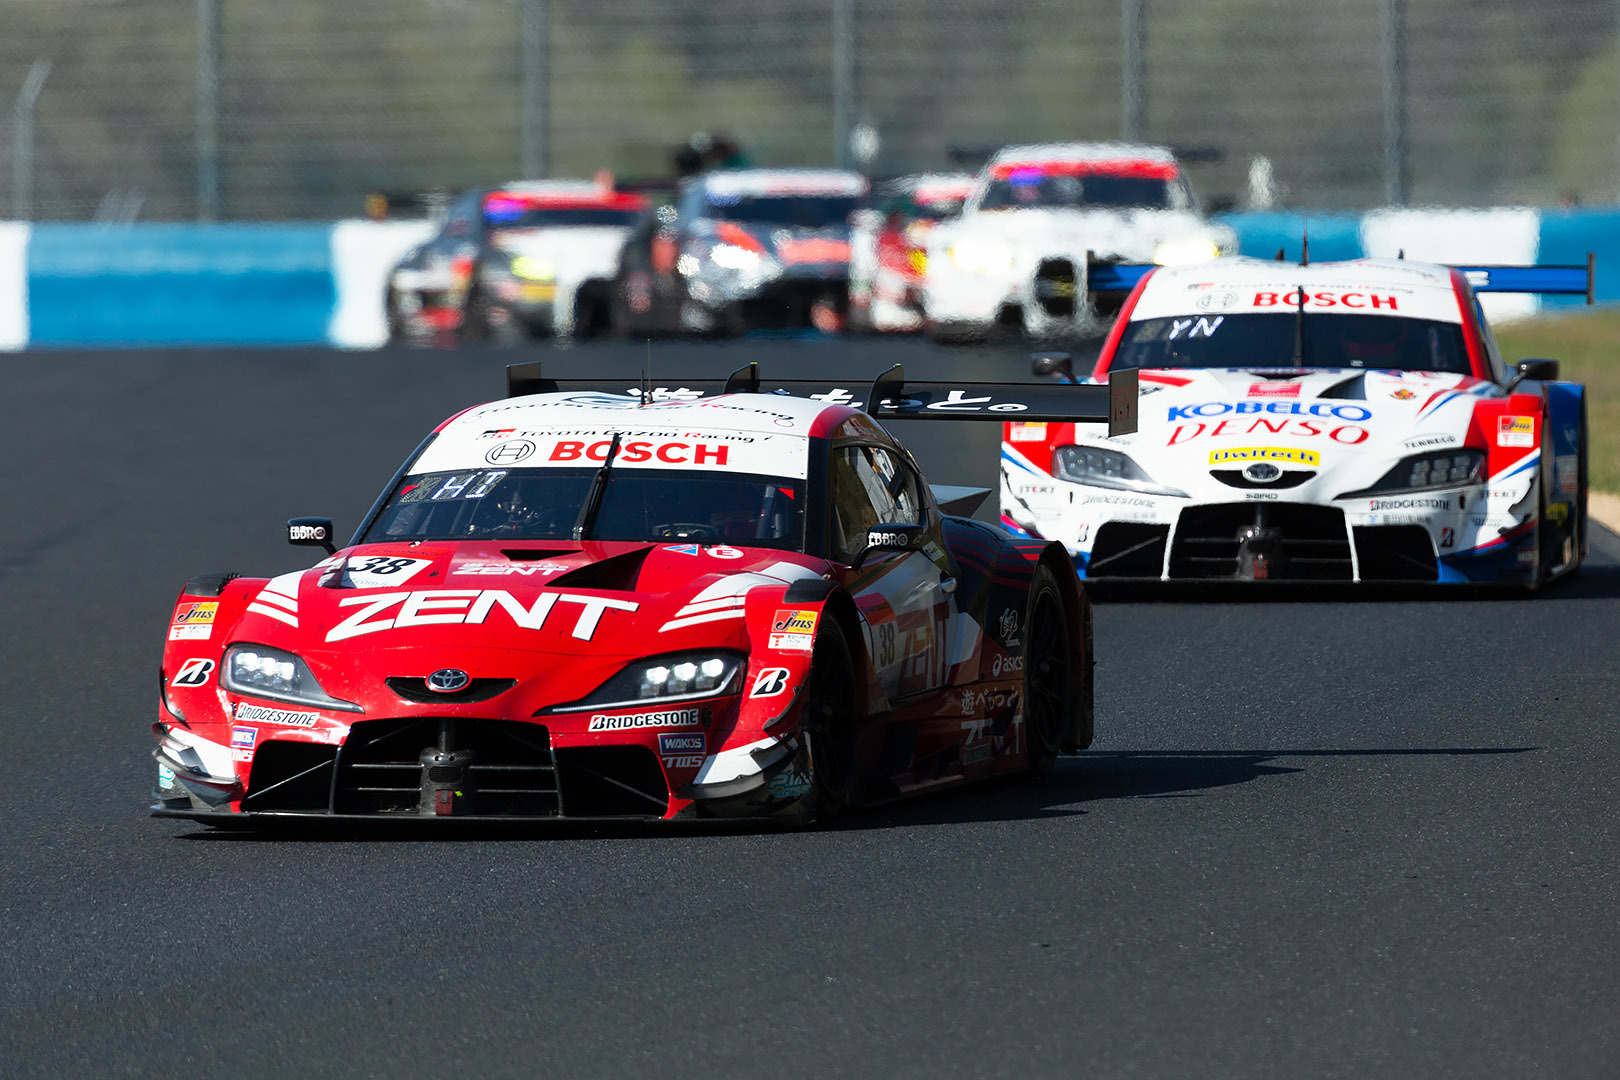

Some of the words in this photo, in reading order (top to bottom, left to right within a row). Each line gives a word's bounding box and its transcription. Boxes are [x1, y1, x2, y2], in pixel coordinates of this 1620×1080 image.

[1253, 292, 1398, 310] BOSCH
[1168, 315, 1225, 340] YN
[1167, 401, 1372, 422] KOBELCO
[684, 432, 755, 443] Racing
[1166, 418, 1370, 447] DENSO
[548, 441, 729, 466] BOSCH
[431, 470, 507, 500] HI
[345, 557, 417, 575] 38
[452, 566, 569, 576] ZENT
[325, 589, 640, 643] ZENT
[775, 611, 814, 630] jms
[879, 622, 896, 667] 38
[1002, 656, 1023, 672] asics
[238, 704, 316, 726] BRIDGESTONE
[591, 709, 699, 730] BRIDGESTONE
[661, 755, 706, 768] TWS
